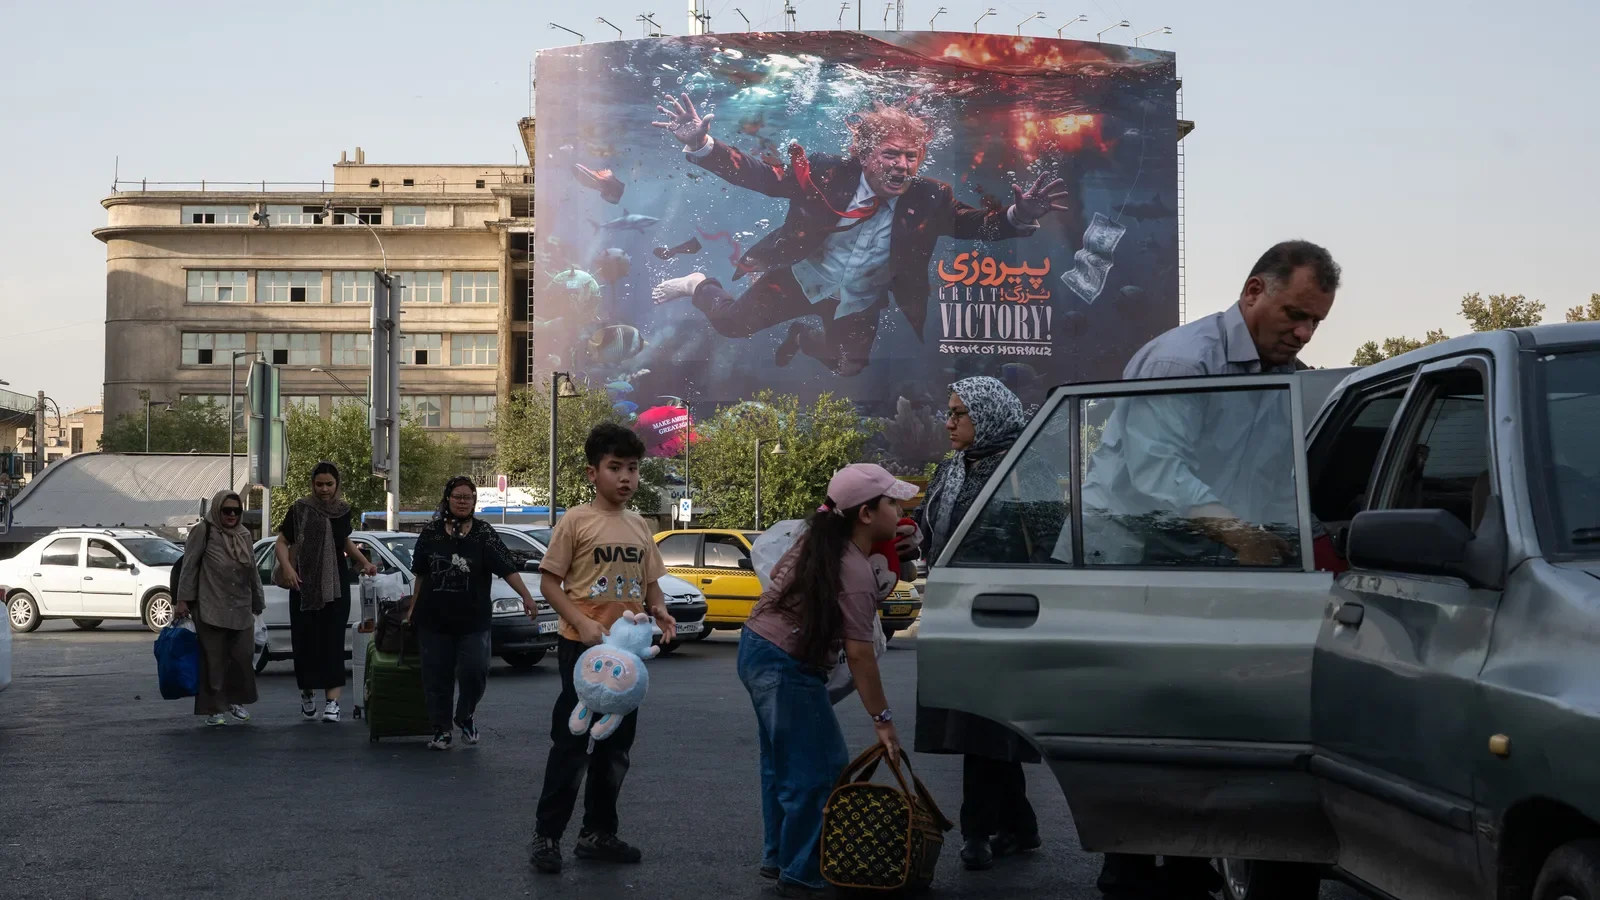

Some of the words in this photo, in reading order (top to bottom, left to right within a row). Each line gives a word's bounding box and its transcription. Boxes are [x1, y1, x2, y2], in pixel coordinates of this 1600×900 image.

[939, 286, 998, 301] GREAT
[940, 303, 1052, 341] VICTORY!
[939, 344, 979, 354] Strait
[652, 419, 671, 430] MAKE
[593, 546, 644, 564] NASA
